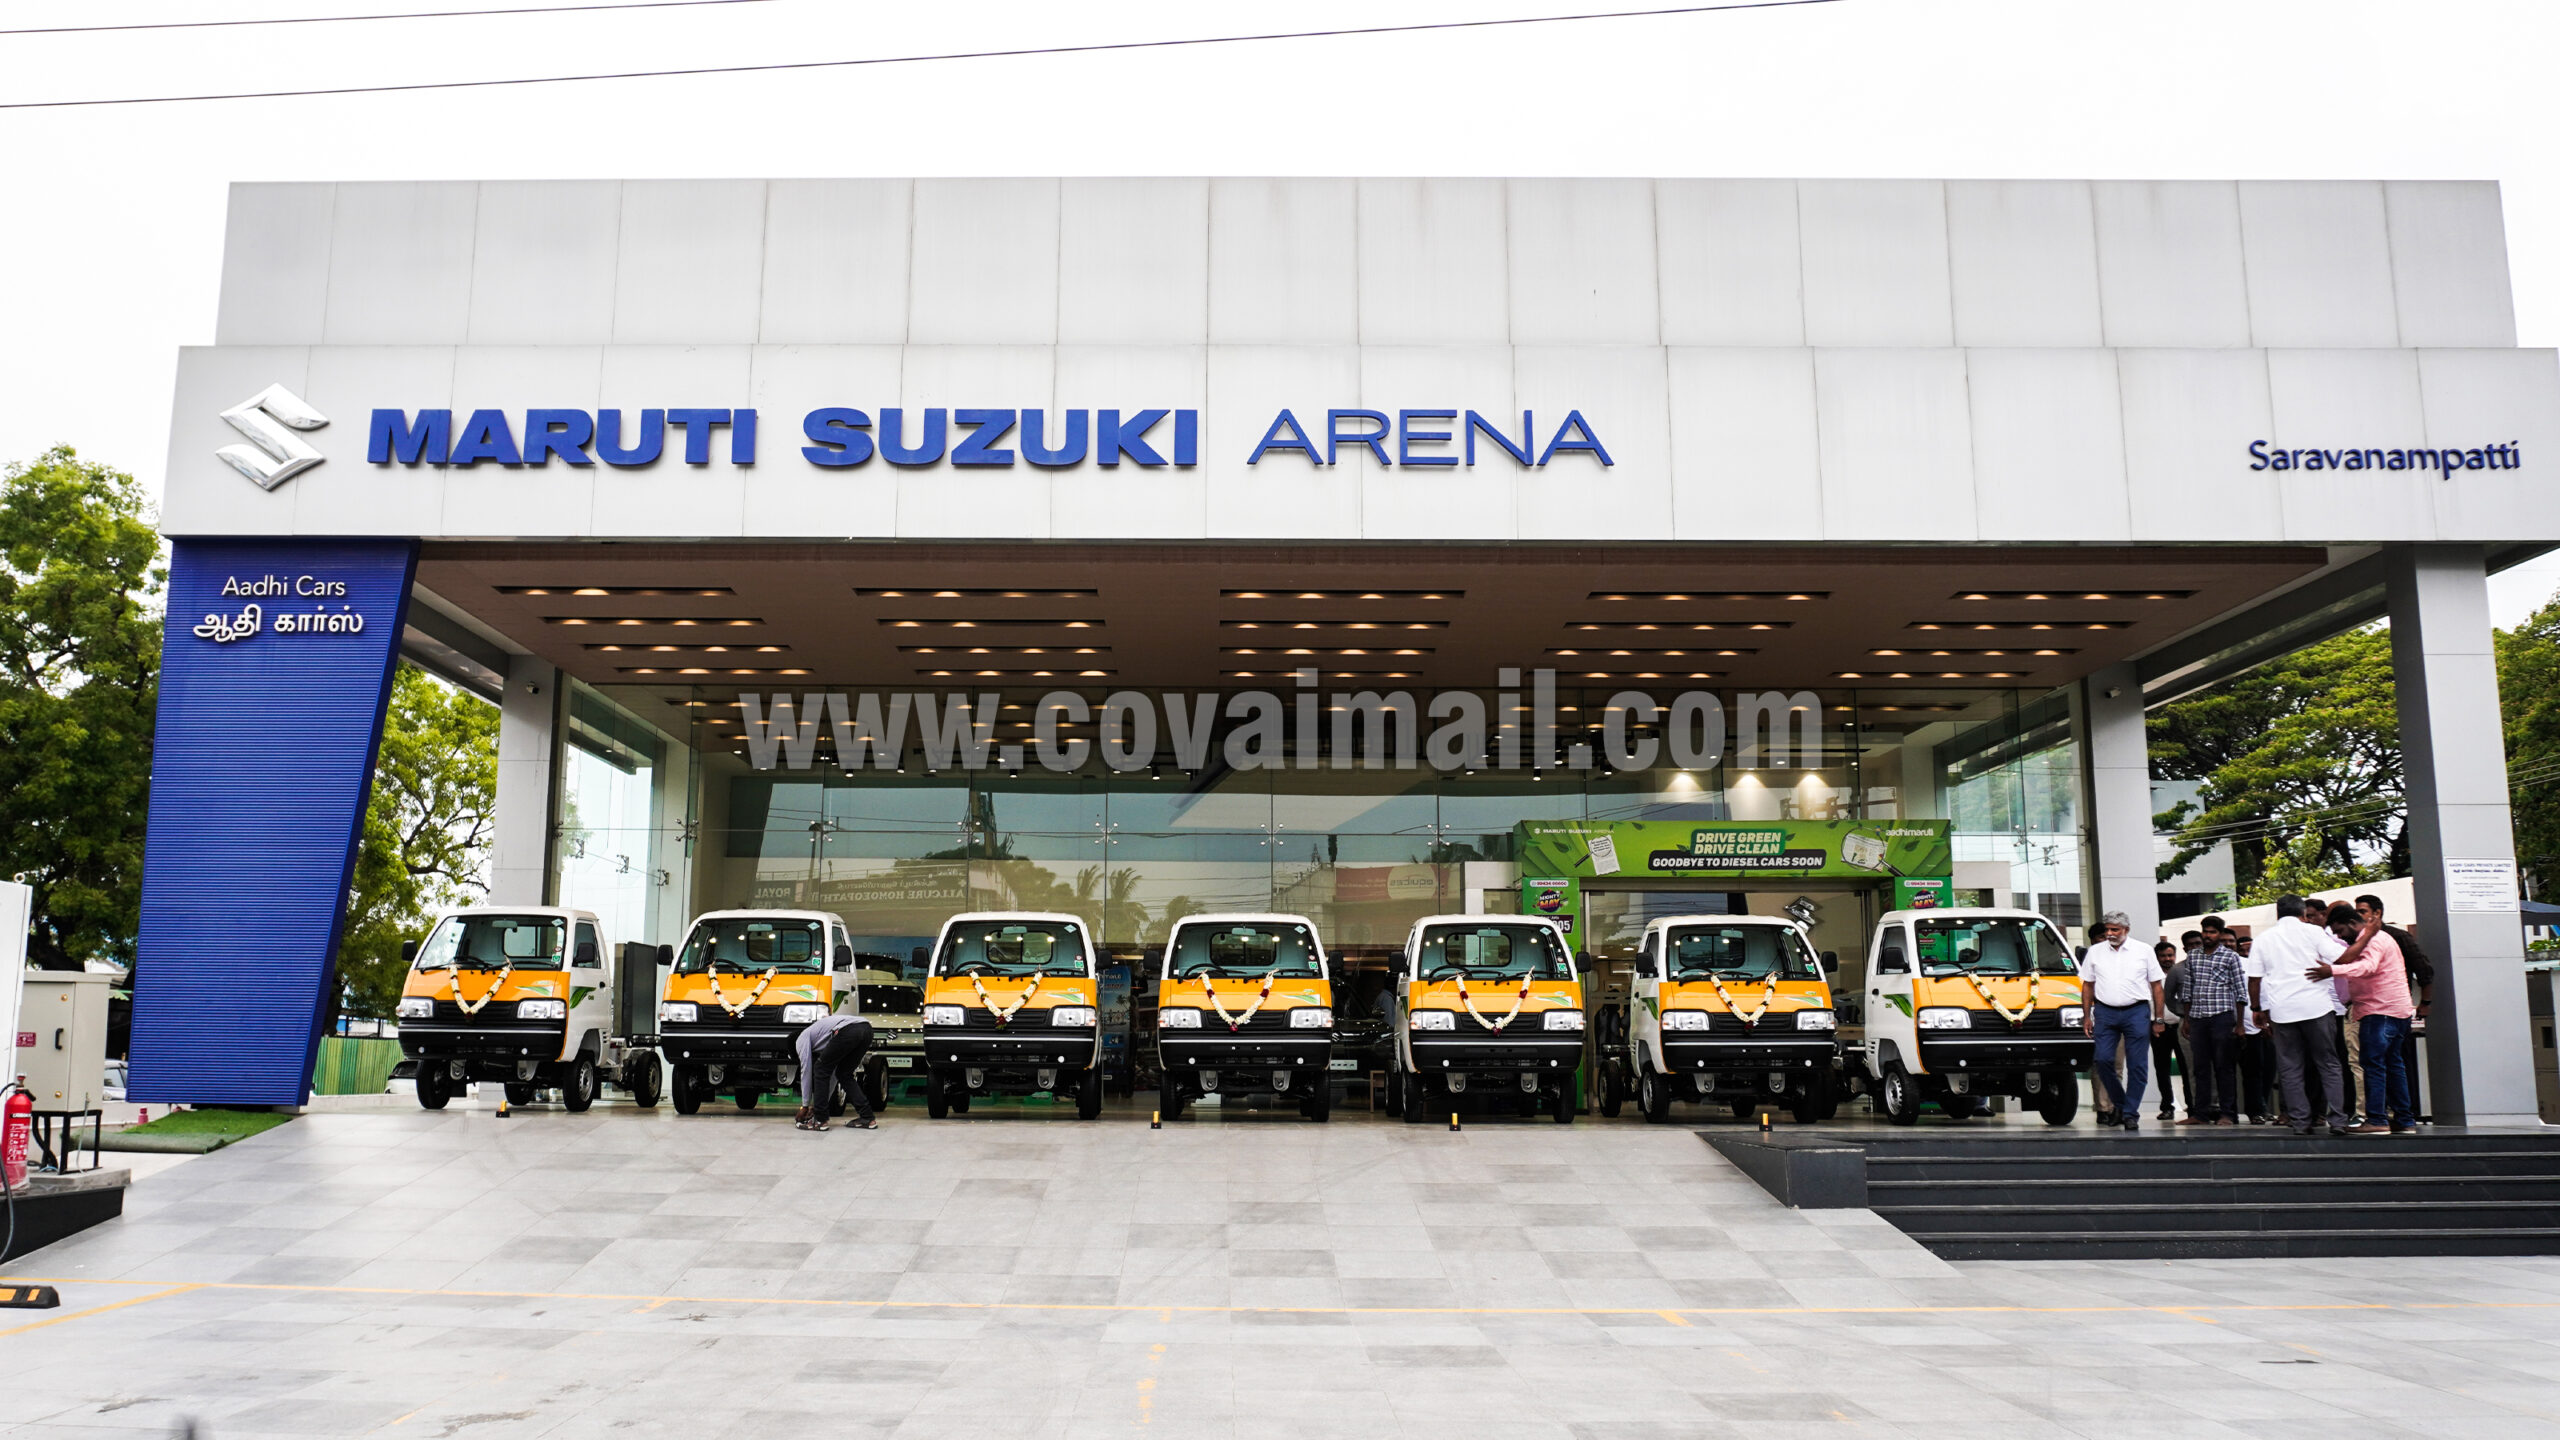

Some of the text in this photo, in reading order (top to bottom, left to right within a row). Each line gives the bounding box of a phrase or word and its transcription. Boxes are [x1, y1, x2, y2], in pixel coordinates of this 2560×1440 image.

[367, 407, 1614, 467] MARUTI SUZUKI ARENA
[2249, 439, 2521, 480] Saravanampatti
[221, 574, 346, 597] Aadhi Cars
[193, 603, 364, 642] ஆதி கார்ஸ்
[1696, 832, 1782, 843] DRIVE GREEN
[1694, 843, 1780, 855] DRIVE CLEAN
[1652, 856, 1823, 868] GOODBYE TO DIESEL CARS SOON
[1540, 899, 1560, 908] MAY
